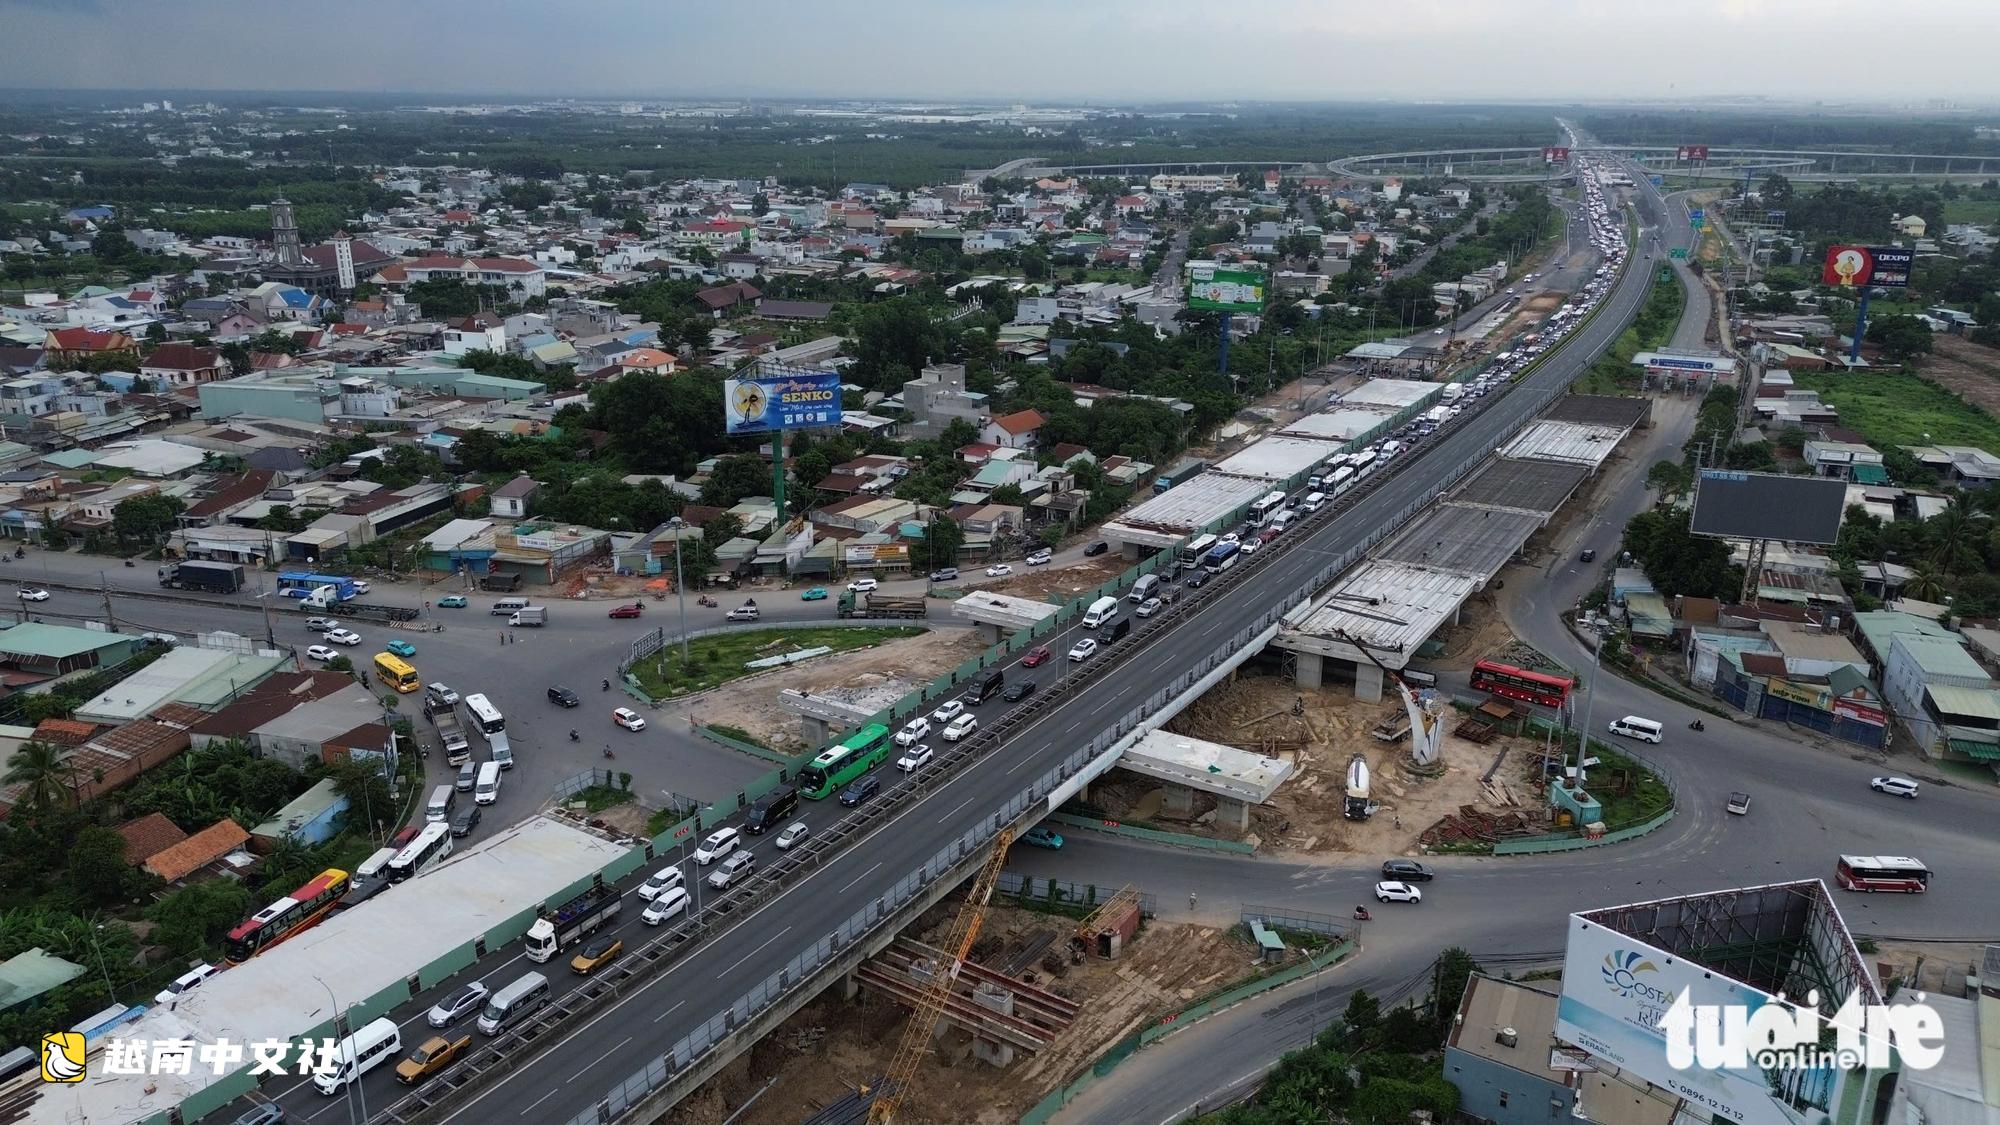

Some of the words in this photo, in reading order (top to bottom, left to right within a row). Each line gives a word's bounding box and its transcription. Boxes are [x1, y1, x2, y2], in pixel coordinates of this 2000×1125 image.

[782, 390, 833, 402] SENKO
[1791, 693, 1810, 703] VINH
[1680, 1085, 1705, 1102] 0896
[1708, 1098, 1718, 1108] 12
[1720, 1105, 1731, 1115] 12
[1733, 1111, 1744, 1121] 12
